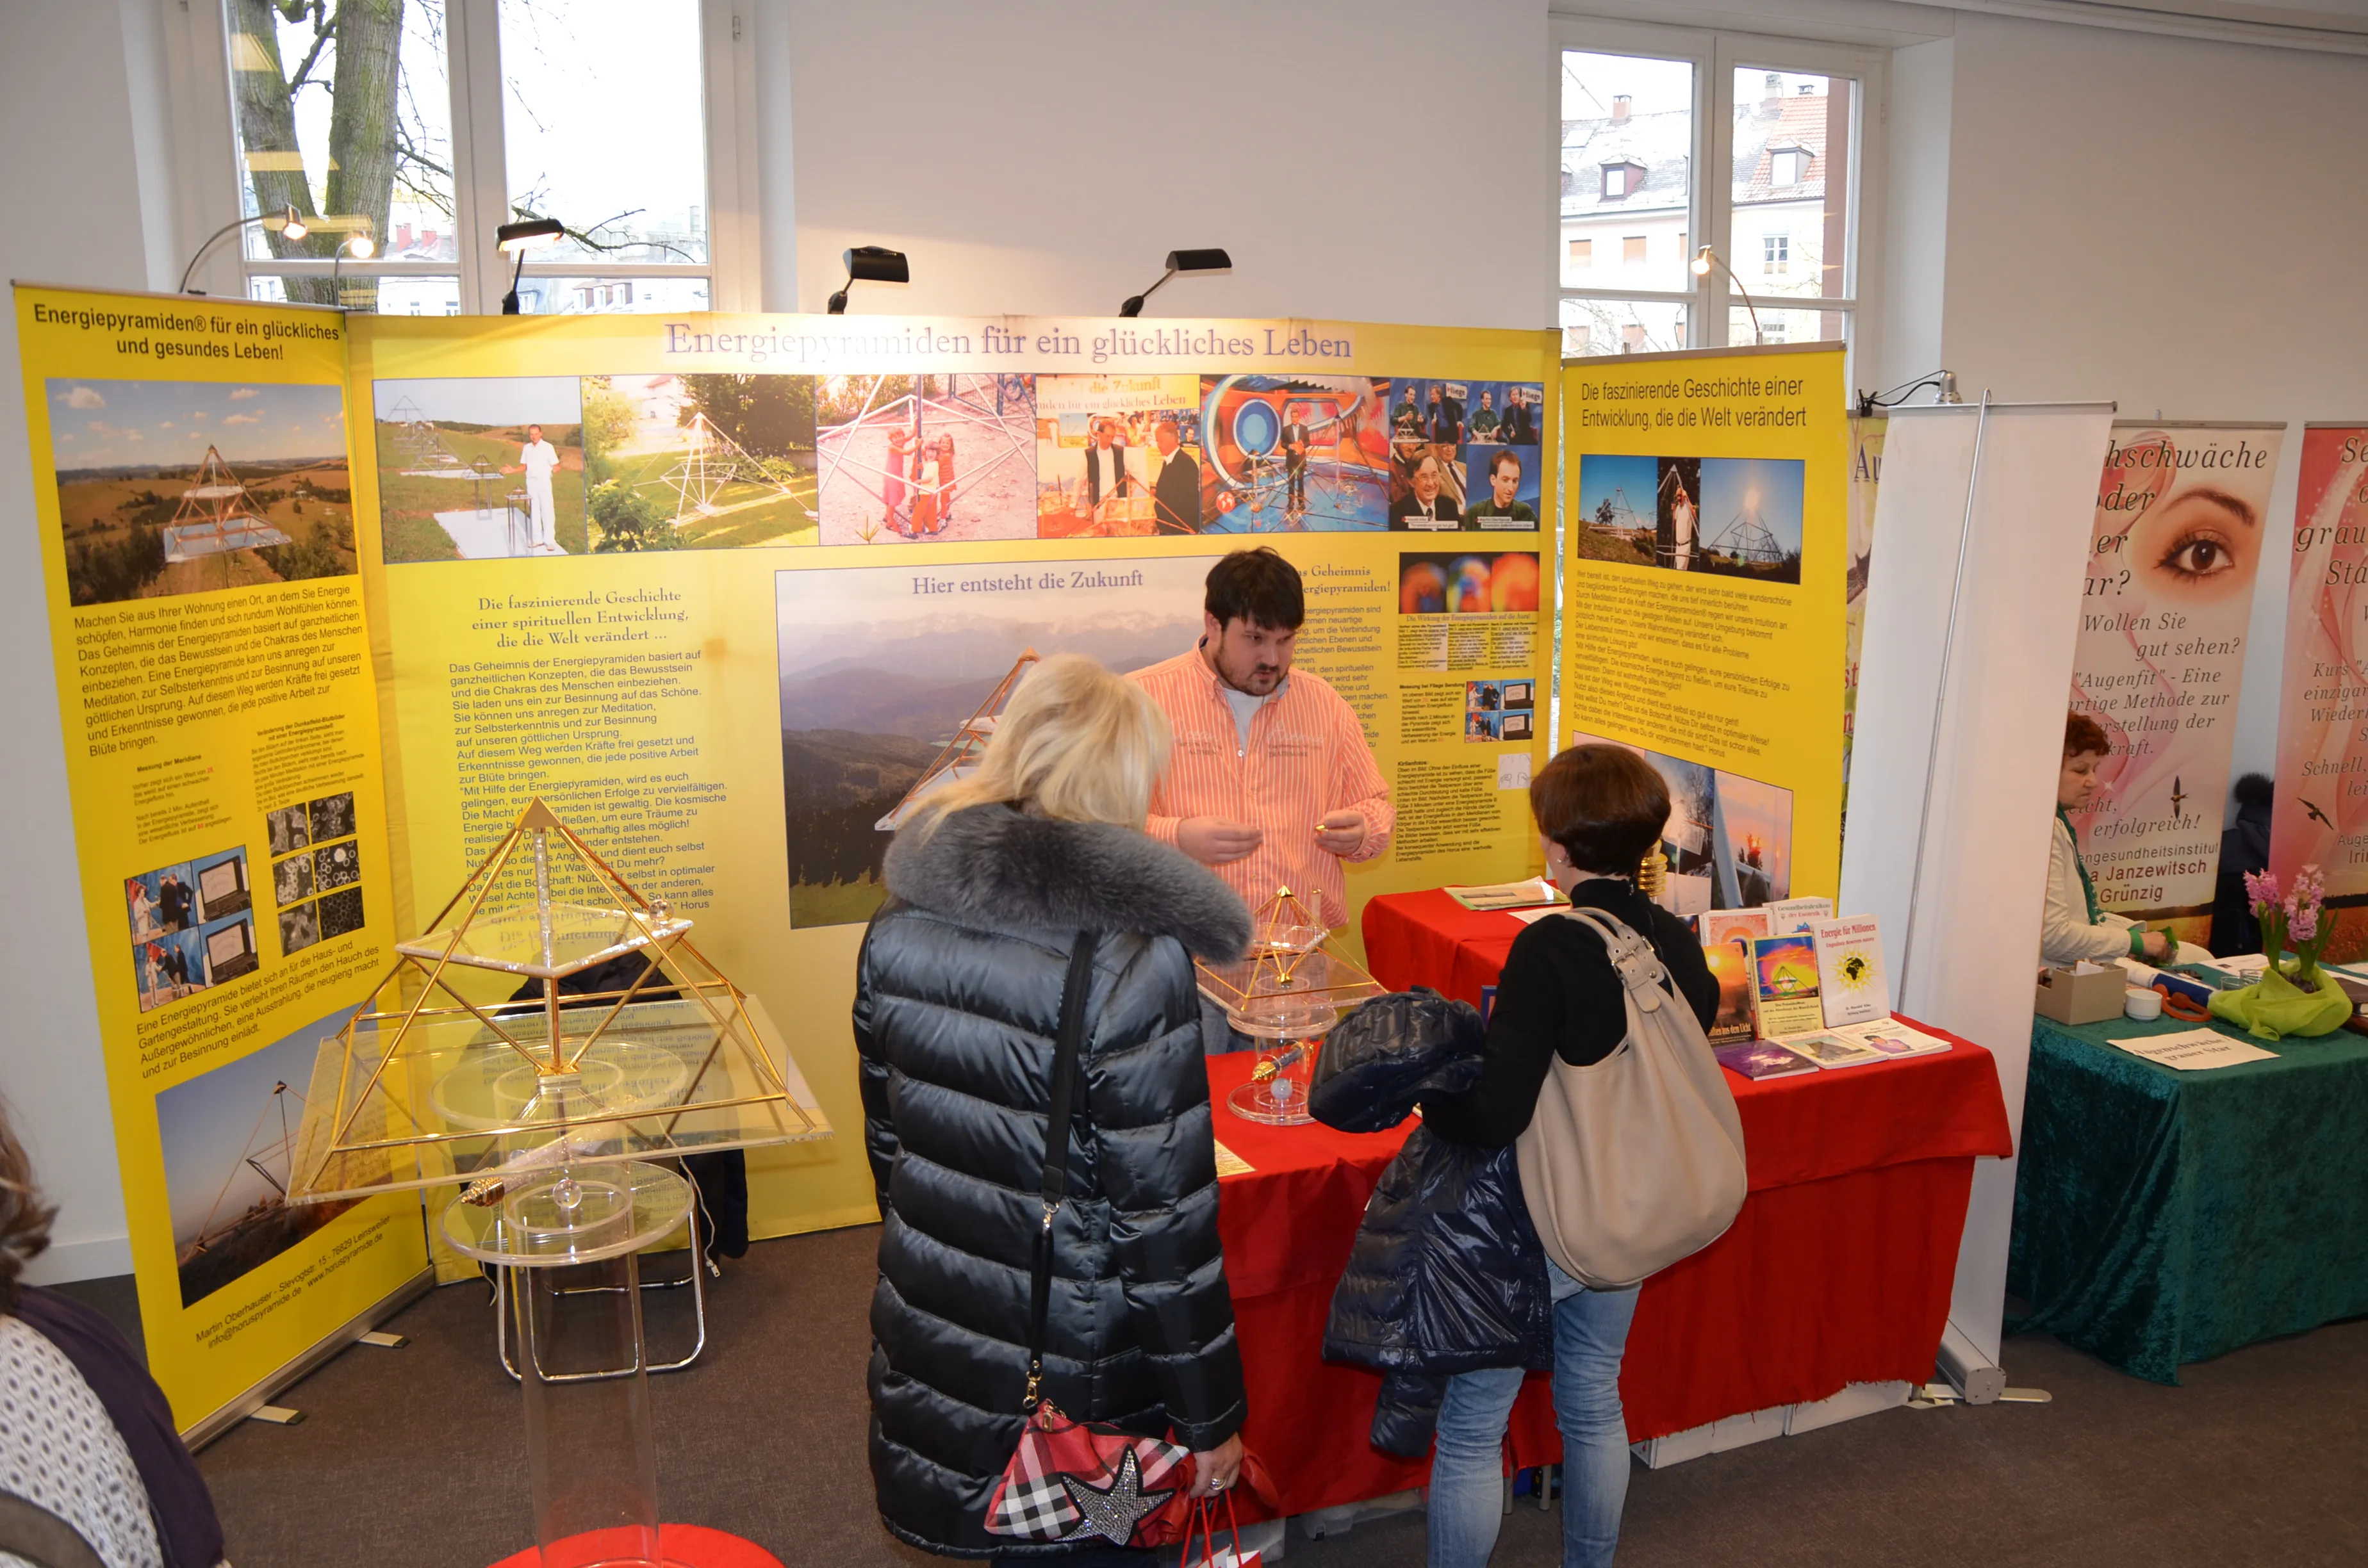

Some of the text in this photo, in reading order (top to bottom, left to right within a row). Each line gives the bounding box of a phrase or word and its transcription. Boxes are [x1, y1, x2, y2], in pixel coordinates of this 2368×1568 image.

[33, 303, 339, 340] Energiepyramiden® für ein glückliches
[116, 337, 283, 360] und gesundes Leben!
[665, 322, 1352, 364] Energiepyramiden für ein glückliches Leben
[1153, 395, 1186, 405] Leben
[1581, 377, 1804, 400] Die faszinierende Geschichte einer
[1582, 407, 1807, 432] Entwicklung, die die Welt verändert
[2096, 484, 2155, 510] der
[2089, 533, 2128, 554] er
[912, 569, 1144, 594] Hier entsteht die Zukunft
[1311, 564, 1370, 576] Geheimnis
[74, 585, 350, 630] Machen Sie aus Ihrer Wohnung einen Ort, an dem Sie Energie
[479, 586, 681, 610] Die faszinierende Geschichte
[76, 600, 359, 646] schöpfen, Harmonie finden und sich rundum Wohlfühlen können.
[472, 607, 688, 633] einer spirituellen Entwicklung,
[2085, 612, 2186, 632] Wollen Sie
[496, 633, 518, 648] die
[522, 632, 543, 647] die
[548, 629, 579, 646] Welt
[584, 626, 649, 644] verändert
[2135, 637, 2240, 661] gut sehen?
[448, 649, 701, 673] Das Geheimnis der Energiepyramiden basiert auf
[2313, 663, 2349, 677] Kurs
[2075, 669, 2165, 690] "Augenfit"
[2182, 668, 2221, 683] Eine
[2123, 691, 2195, 709] Methode
[2201, 693, 2230, 705] zur
[2186, 713, 2216, 729] der
[2302, 756, 2366, 776] Schnell,
[2094, 814, 2201, 839] erfolgreich!
[2349, 849, 2368, 863] Iri
[2106, 860, 2207, 881] Janzewitsch
[2100, 884, 2163, 902] Grünzig
[1821, 924, 1876, 940] Energie für Millionen
[136, 940, 353, 1035] Eine Energiepyramide bietet sich an für die Haus- und
[195, 1321, 224, 1343] Martin
[224, 1291, 272, 1325] Oberhauser
[278, 1266, 316, 1293] Slevogtstr.
[318, 1255, 327, 1268] 15
[331, 1239, 353, 1259] 76829
[352, 1216, 391, 1245] Leinsweiler
[208, 1232, 383, 1349] info@horuspyramide.de www.horuspyramide.de
